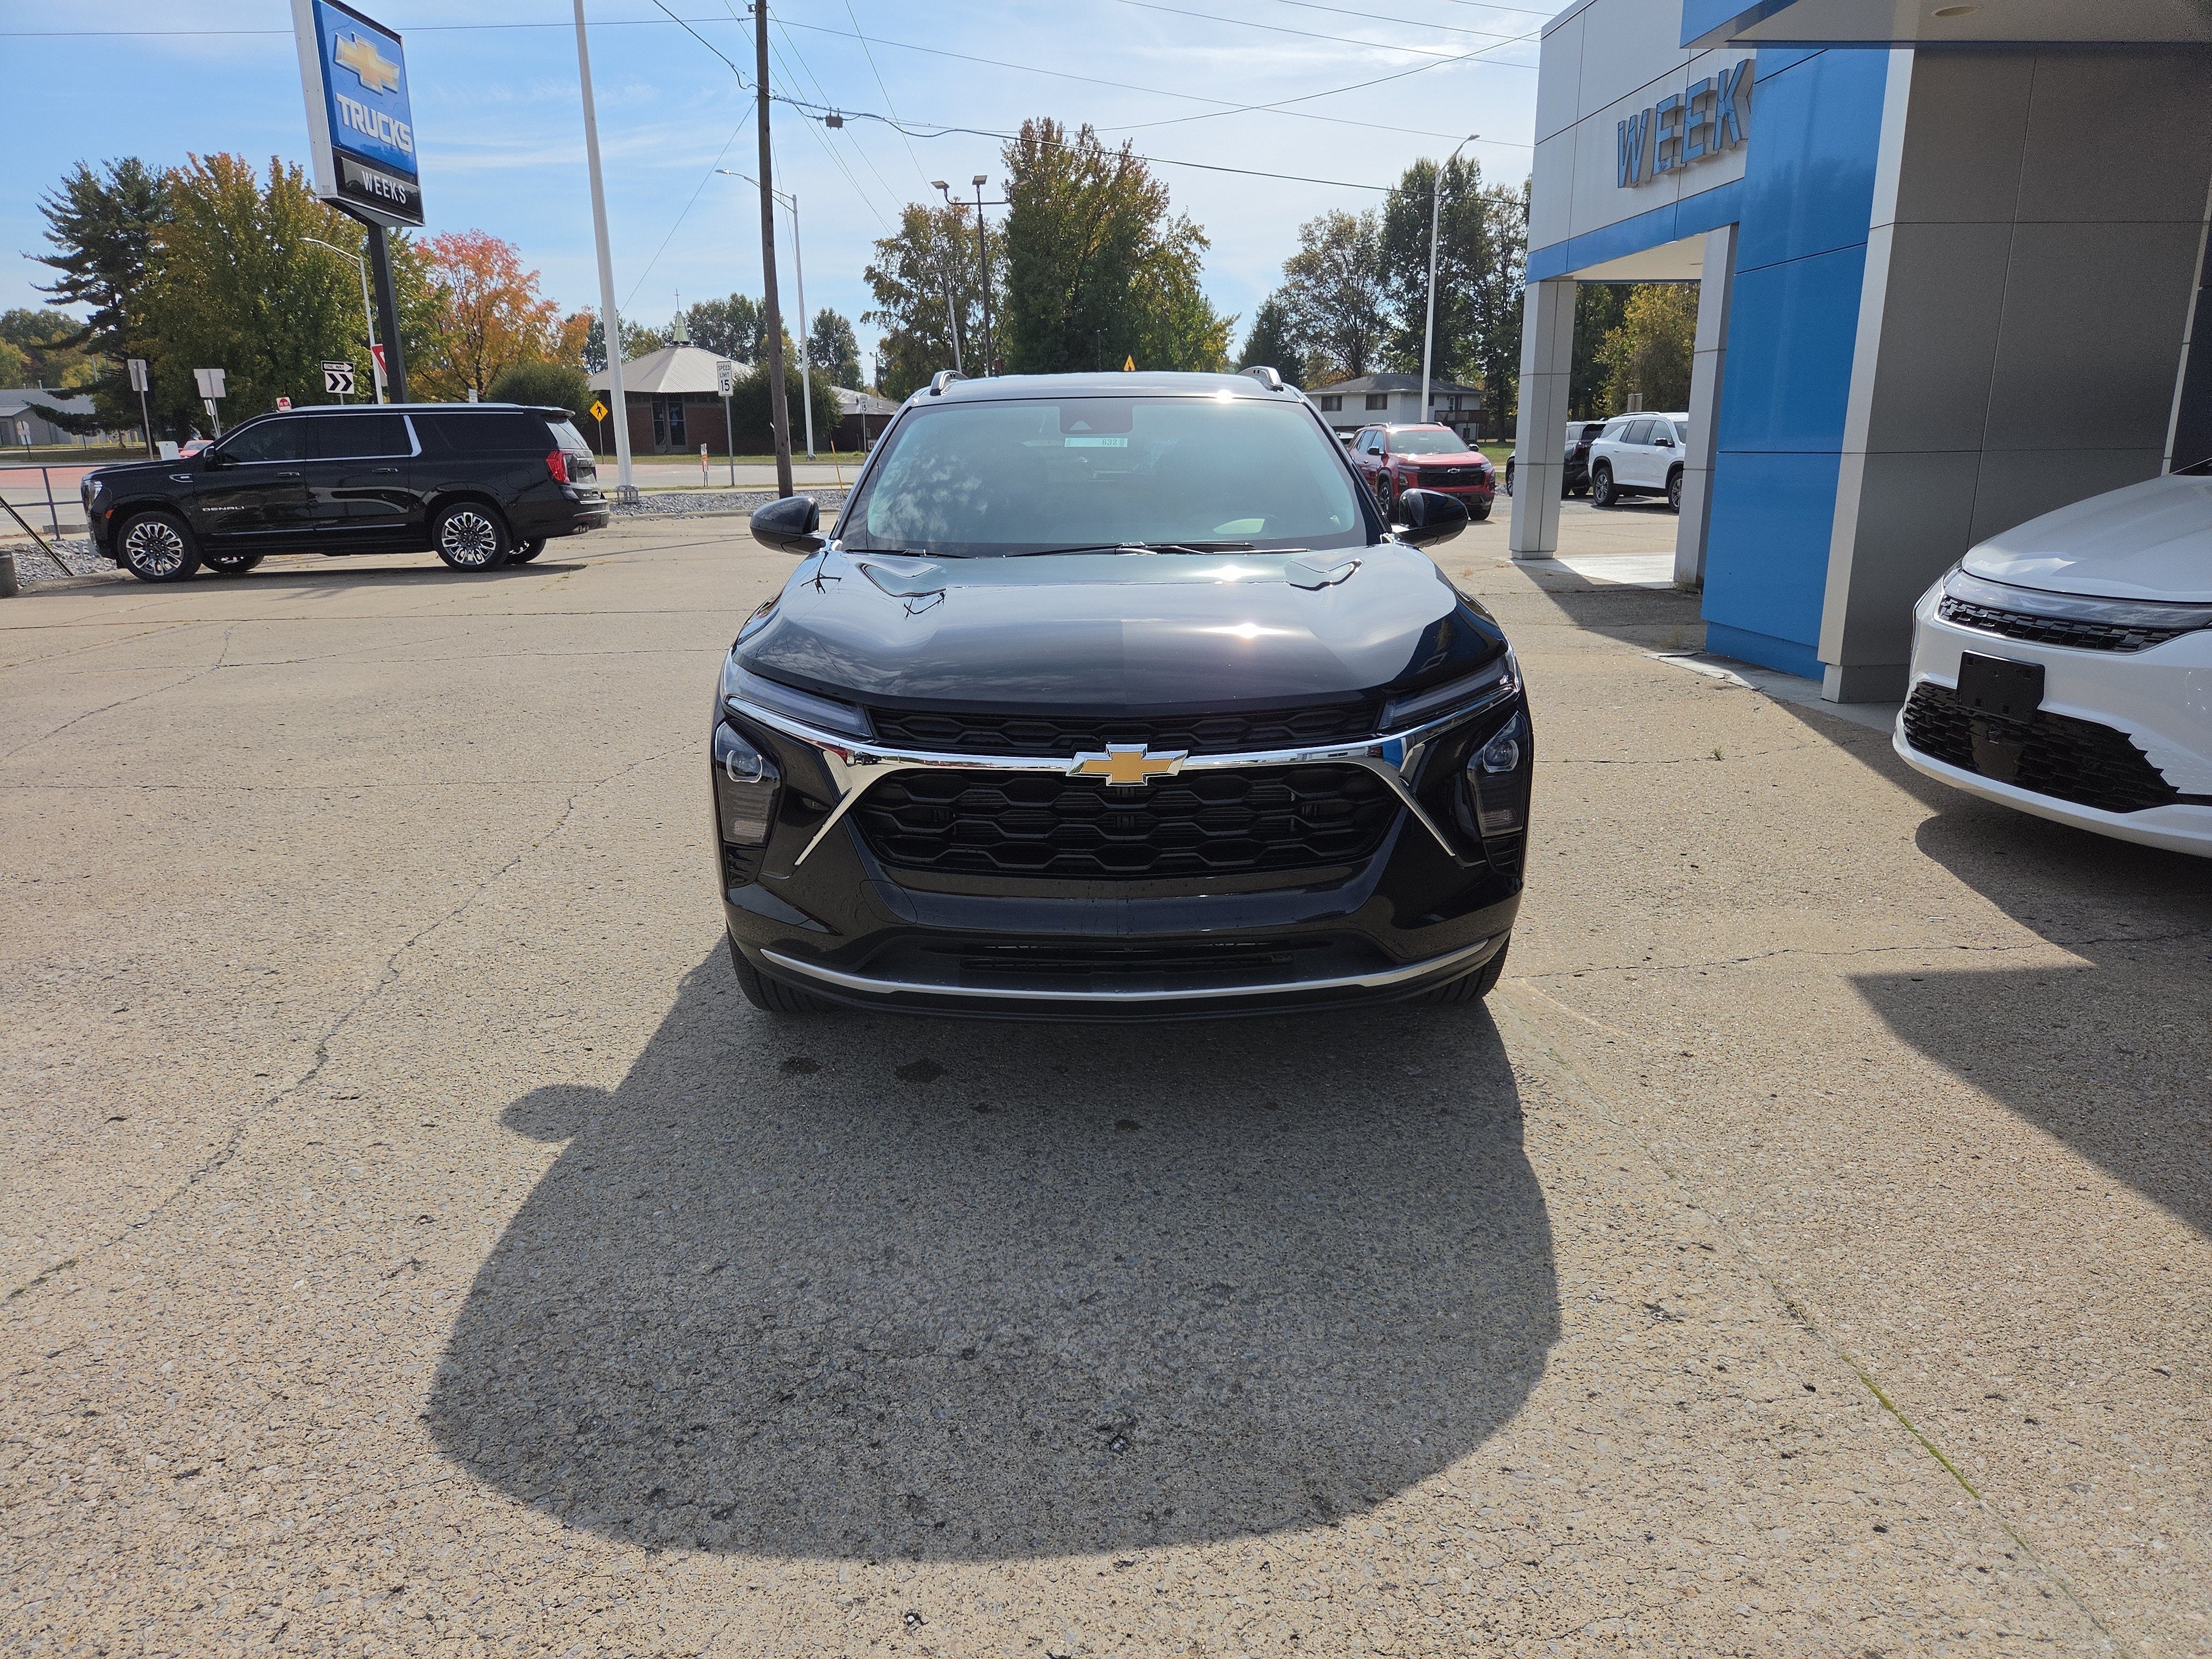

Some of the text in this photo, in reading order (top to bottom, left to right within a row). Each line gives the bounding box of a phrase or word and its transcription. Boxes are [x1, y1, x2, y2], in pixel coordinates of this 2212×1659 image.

[336, 92, 413, 153] TRUCKS
[362, 170, 406, 204] WEEKS
[721, 379, 730, 391] 15
